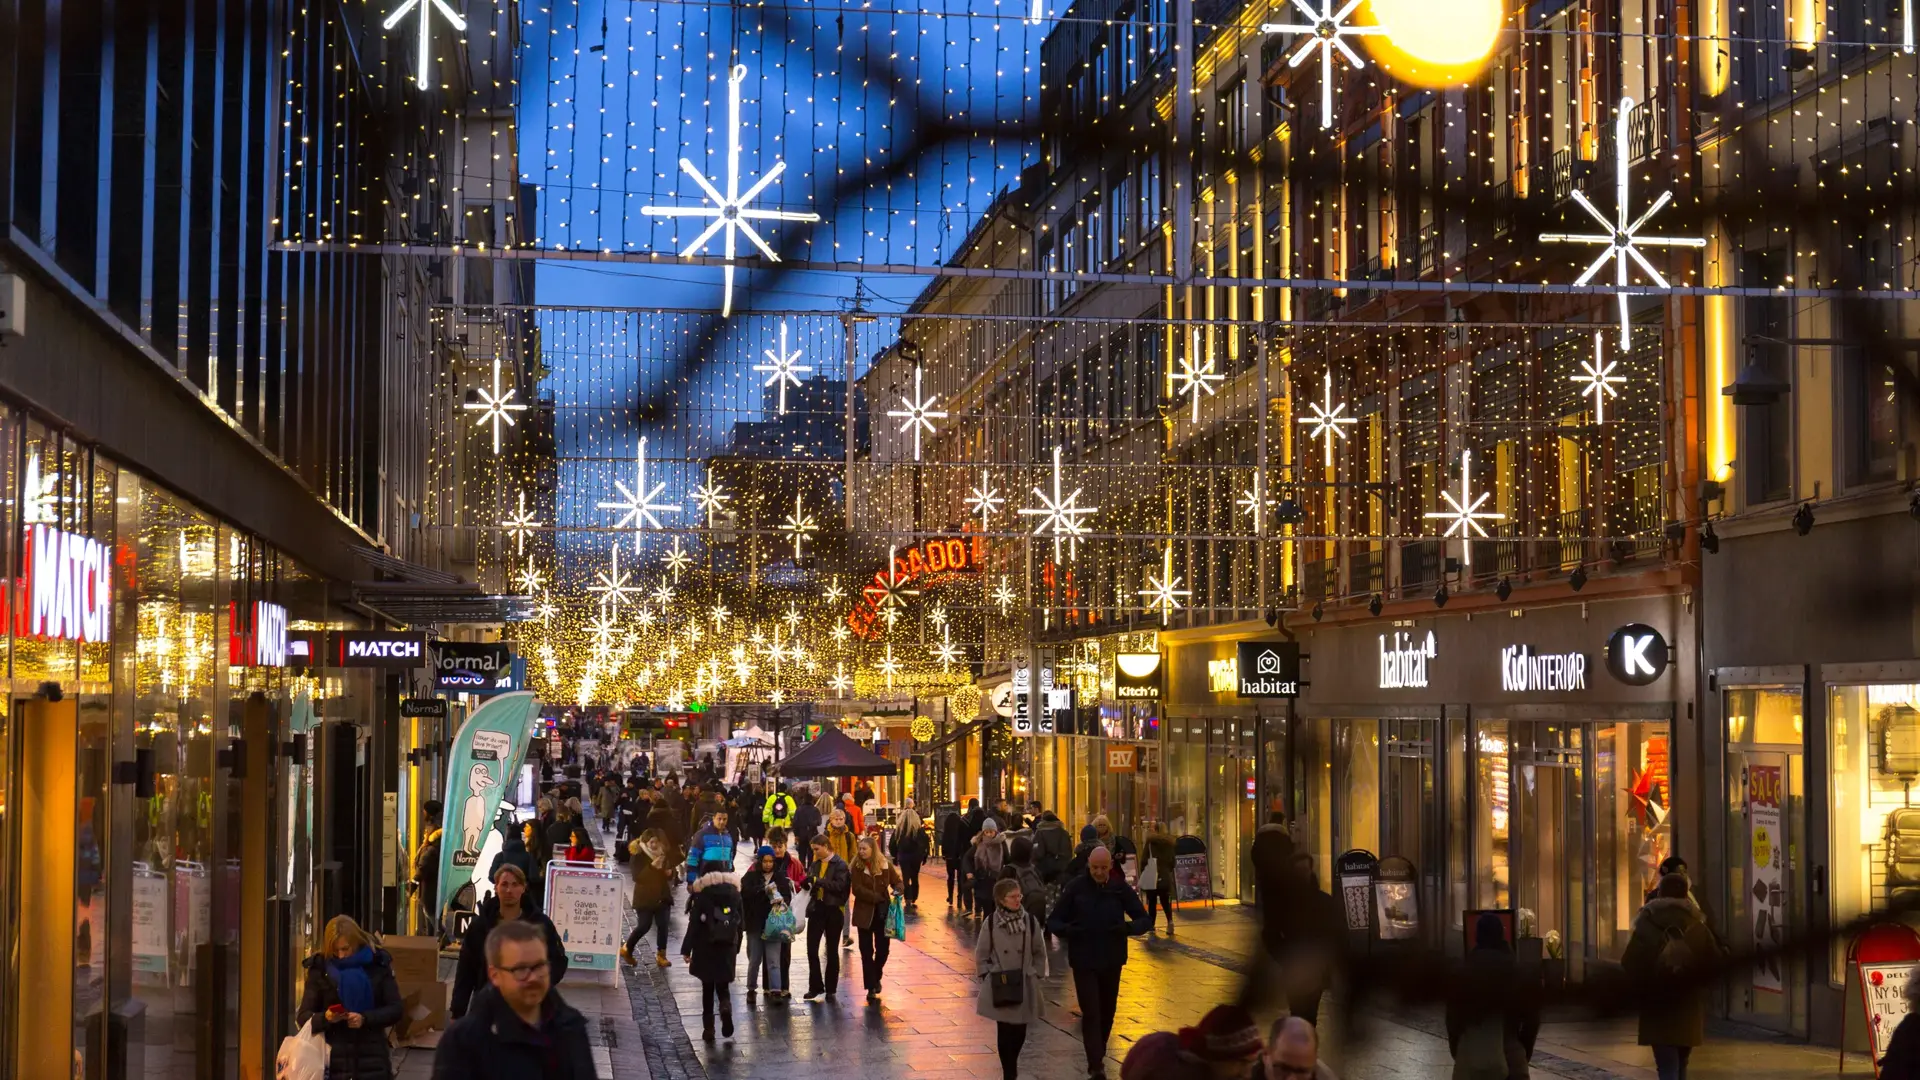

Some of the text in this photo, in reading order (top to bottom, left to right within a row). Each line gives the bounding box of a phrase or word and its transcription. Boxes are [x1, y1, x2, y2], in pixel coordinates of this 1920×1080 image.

[33, 523, 110, 642] MATCH
[257, 600, 287, 667] MATCH
[349, 640, 420, 657] MATCH
[1624, 635, 1656, 675] K
[434, 647, 500, 670] Normal
[1379, 631, 1428, 689] habitat
[1502, 644, 1585, 691] Kid INTERIØR
[1242, 677, 1297, 695] habitat
[406, 703, 443, 714] Normal
[1344, 861, 1371, 871] habitat
[574, 900, 598, 908] Gaven
[1875, 987, 1889, 1000] NY
[1876, 1002, 1895, 1015] TIL
